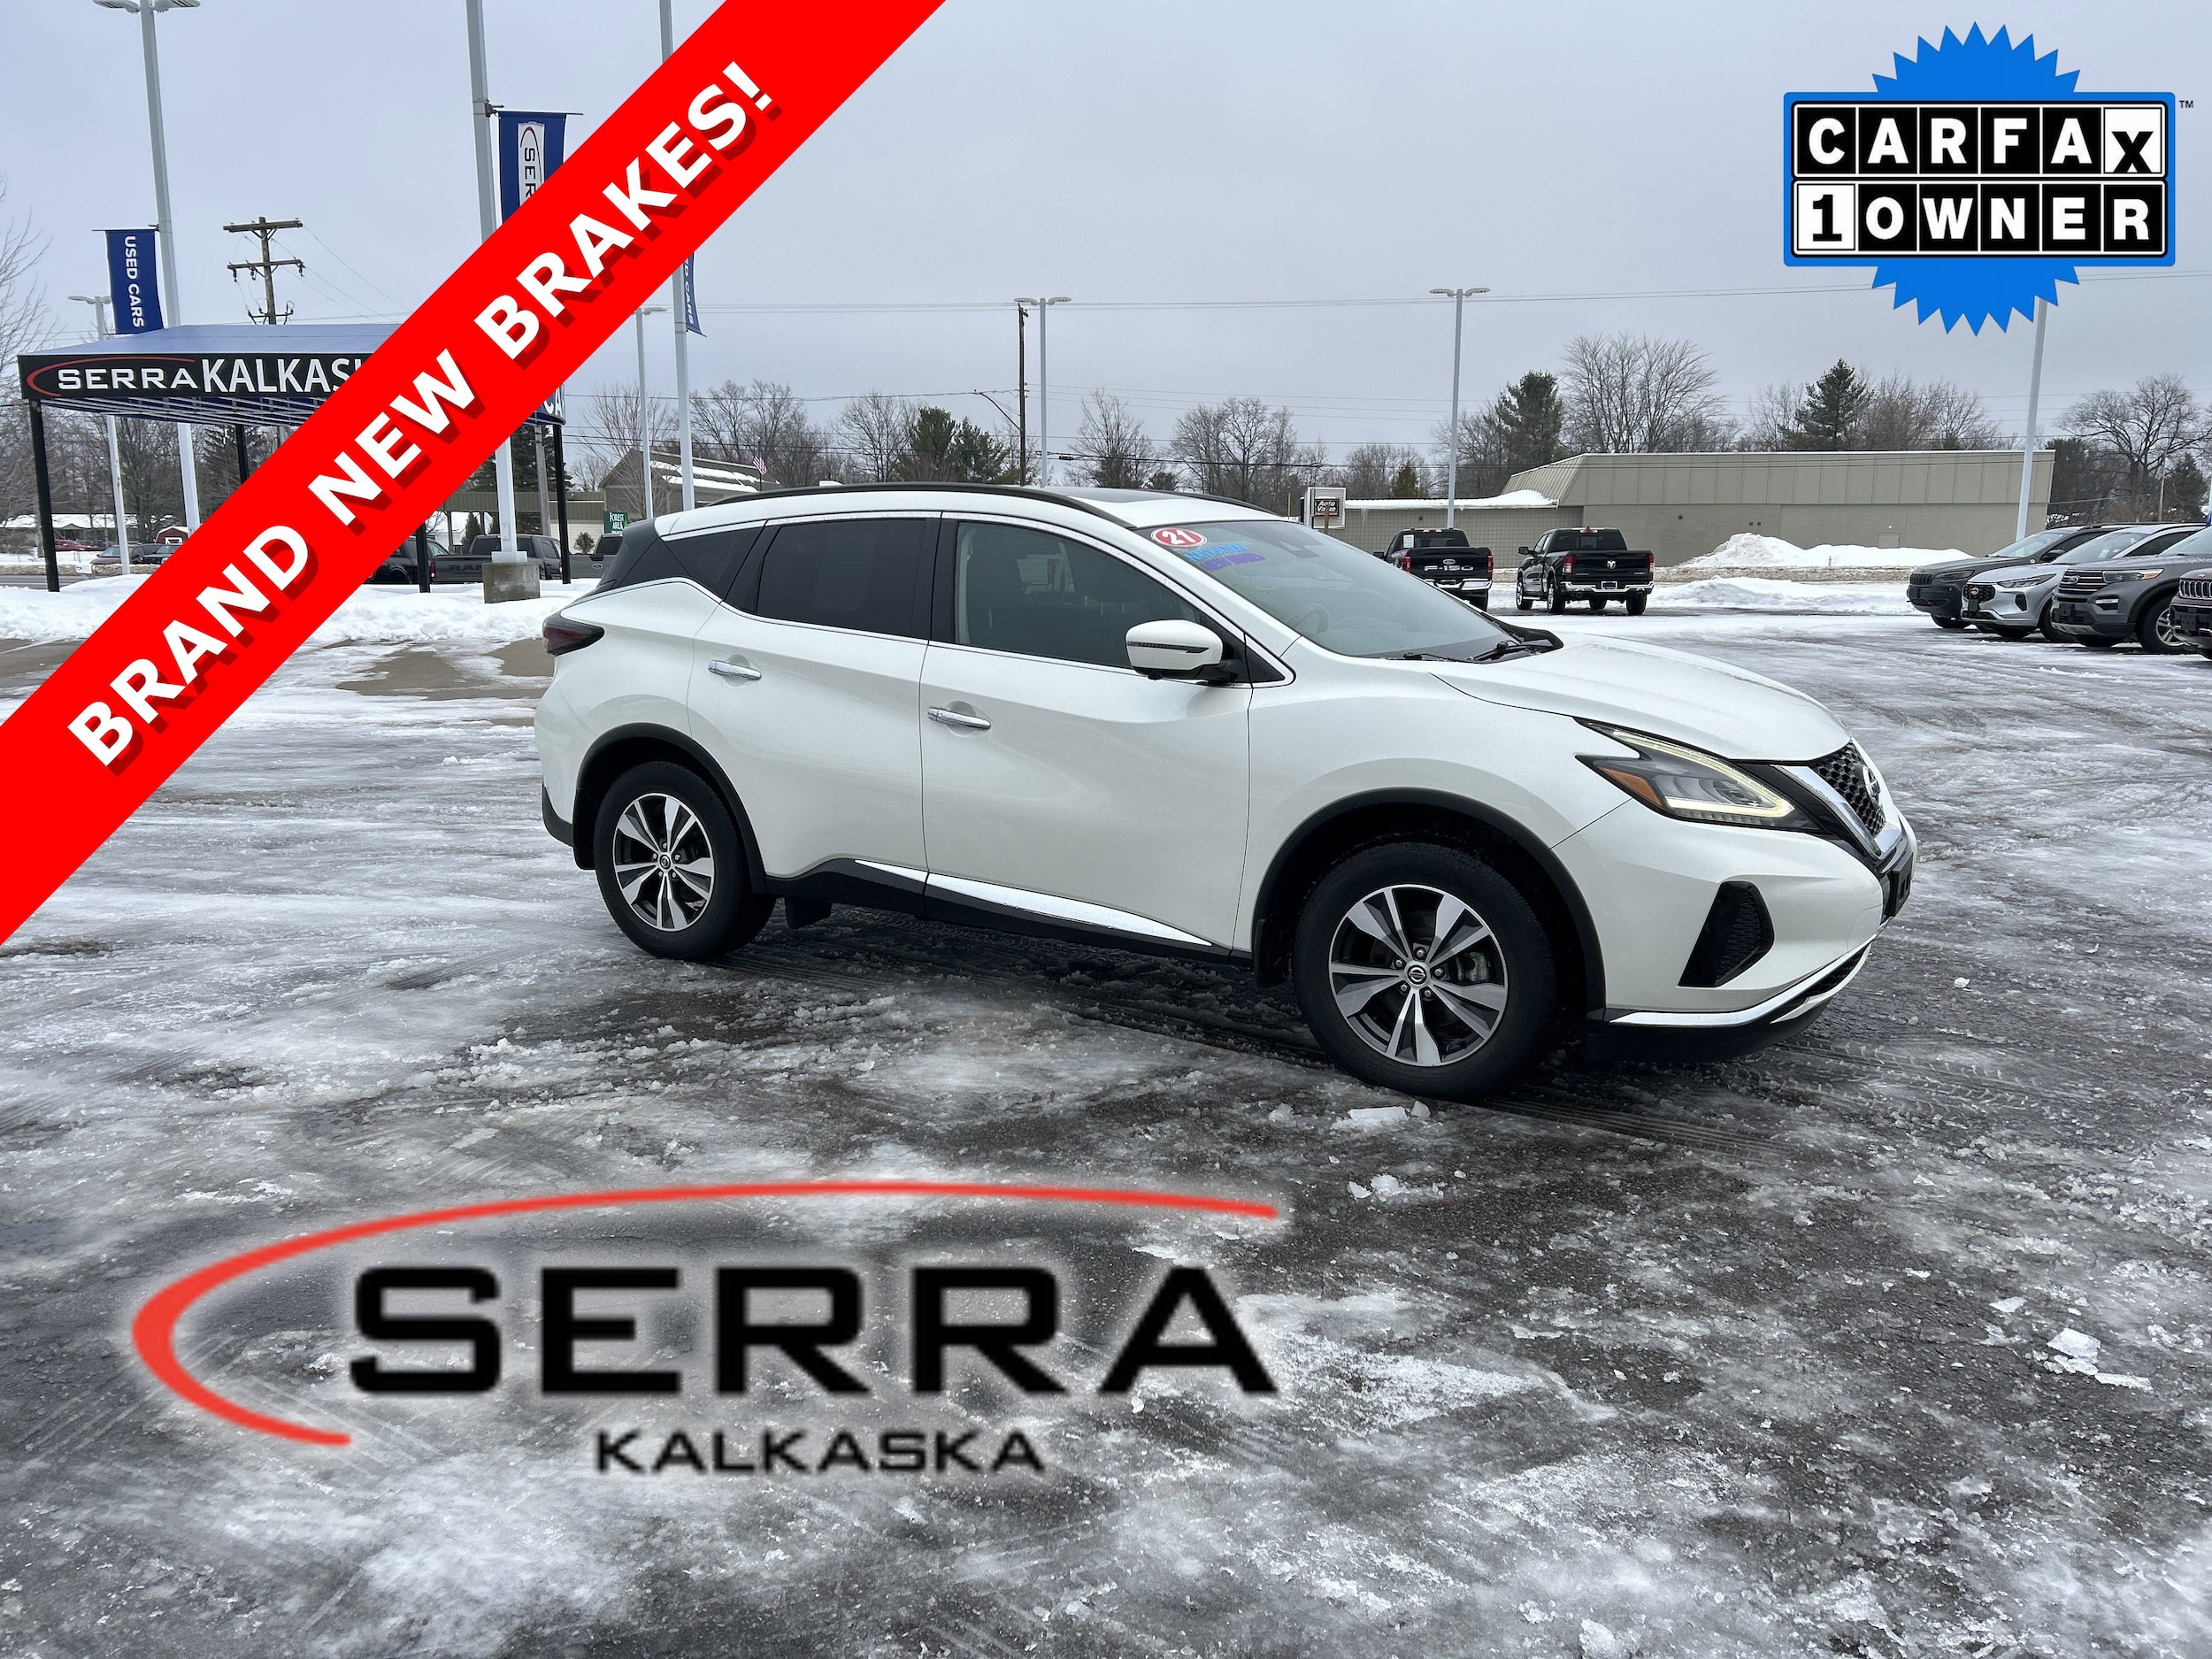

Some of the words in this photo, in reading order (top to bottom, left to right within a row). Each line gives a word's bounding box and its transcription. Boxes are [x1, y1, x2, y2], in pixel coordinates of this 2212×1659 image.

[124, 235, 138, 280] USED
[127, 283, 144, 327] CARS
[58, 368, 198, 389] SERRA
[1162, 529, 1197, 545] 21
